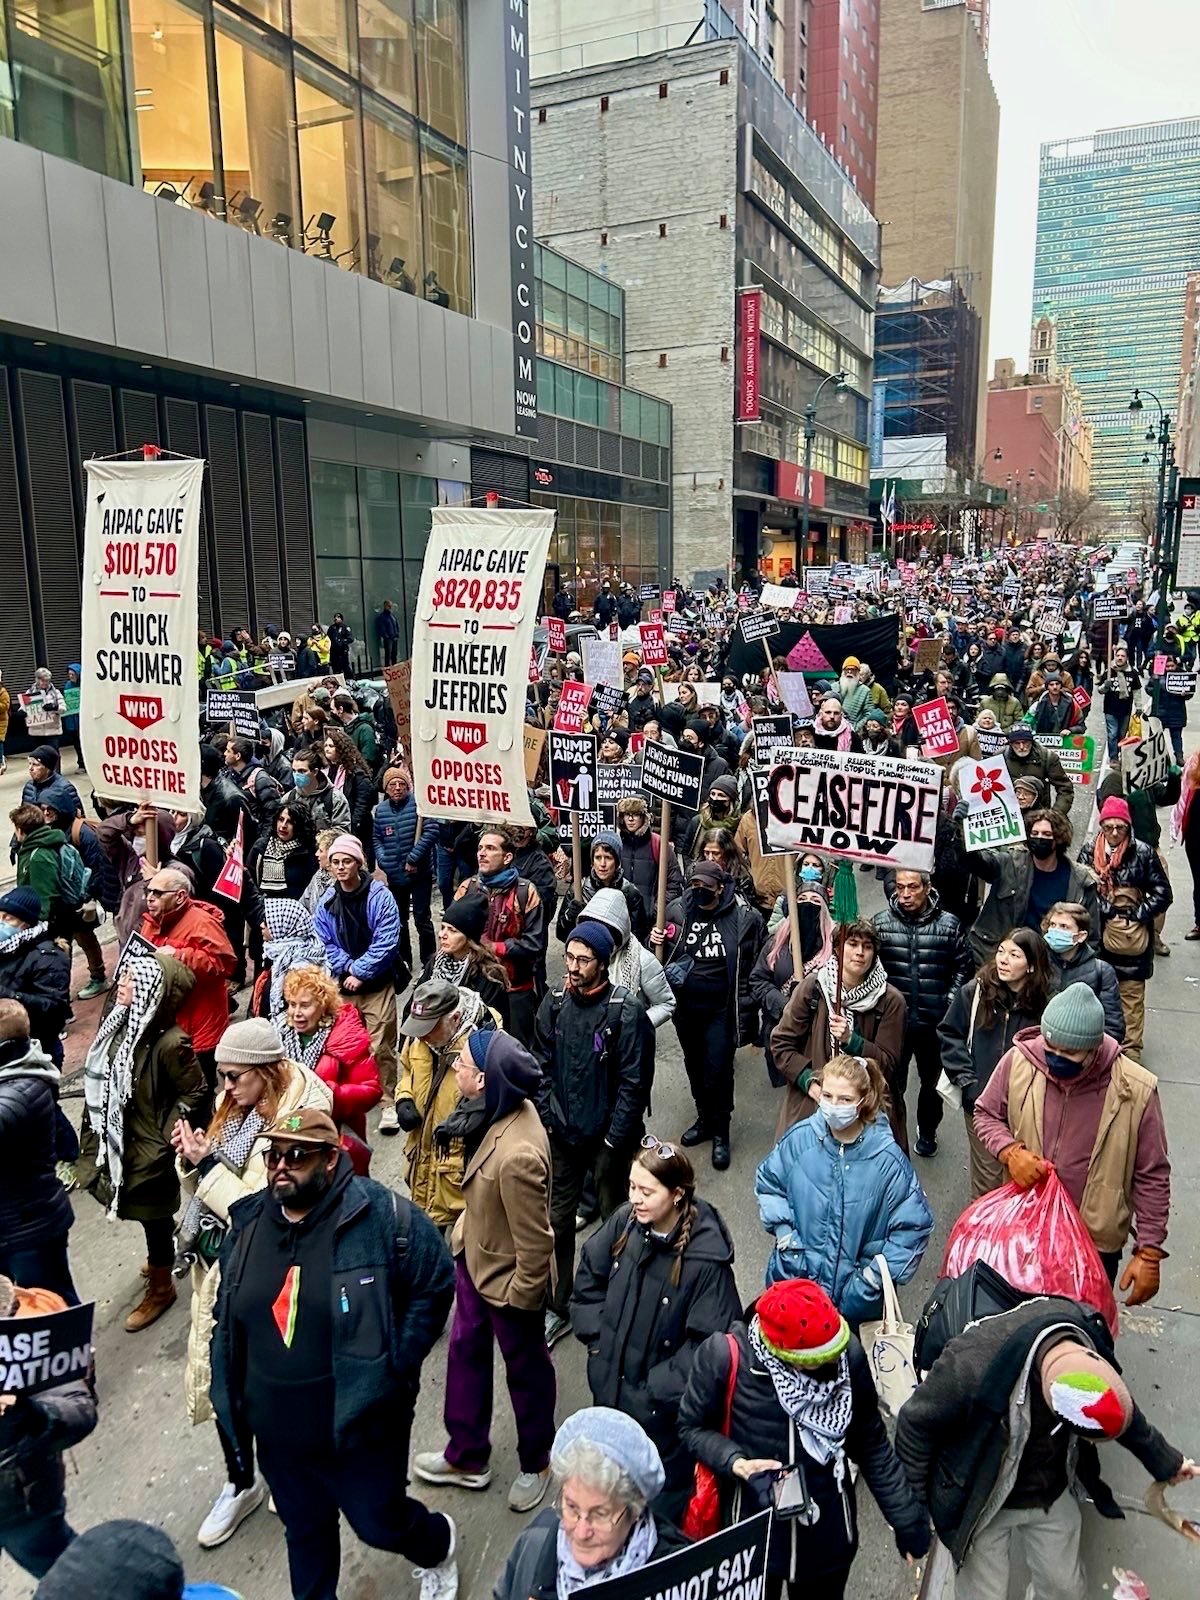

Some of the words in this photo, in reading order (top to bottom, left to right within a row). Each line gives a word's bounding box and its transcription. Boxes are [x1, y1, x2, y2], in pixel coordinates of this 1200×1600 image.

[747, 300, 755, 333] LYCEUM
[746, 337, 755, 377] KENNEDY
[516, 390, 536, 407] NOW
[746, 379, 754, 414] SCHOOL
[516, 405, 537, 419] LEASING
[102, 508, 143, 535] AIPAC
[147, 508, 184, 535] GAVE
[104, 541, 177, 579] $101,570
[438, 549, 484, 572] AIPAC
[486, 551, 529, 574] GAVE
[132, 586, 146, 603] TO
[432, 577, 522, 612] $829,835
[110, 611, 168, 646] CHUCK
[464, 620, 479, 635] TO
[644, 630, 659, 640] LET
[642, 640, 664, 649] GAZA
[646, 649, 664, 659] LIVE
[96, 649, 182, 686] SCHUMER
[432, 642, 507, 676] HAKEEM
[425, 679, 508, 714] JEFFRIES
[566, 689, 585, 702] LET
[1074, 692, 1086, 704] LET
[124, 700, 158, 719] WHO
[922, 707, 941, 725] LET
[560, 712, 581, 727] LIVE
[920, 719, 952, 738] GAZA
[450, 725, 481, 745] WHO
[552, 737, 592, 750] DUMP
[926, 732, 953, 750] LIVE
[105, 736, 178, 764] OPPOSES
[553, 749, 592, 764] AIPAC
[646, 746, 663, 764] JEWS
[663, 753, 680, 769] SAY:
[812, 753, 836, 762] SIEGE
[800, 758, 840, 770] OCCUPATION
[844, 764, 864, 773] STOP
[878, 769, 905, 779] FUNDING
[847, 757, 876, 767] RELEASE
[102, 763, 186, 795] CEASEFIRE
[431, 759, 502, 785] OPPOSES
[598, 769, 615, 778] EWS
[616, 769, 632, 778] SAY:
[644, 760, 665, 779] AIPAC
[666, 769, 699, 789] FUNDS
[598, 779, 619, 788] IPAC
[643, 773, 683, 798] GENOCIDE
[427, 785, 511, 812] CEASEFIRE
[769, 764, 938, 845] CEASEFIRE
[968, 807, 1003, 820] FREE
[800, 827, 898, 855] NOW
[970, 821, 1020, 844] NOW
[717, 1545, 757, 1591] SAY
